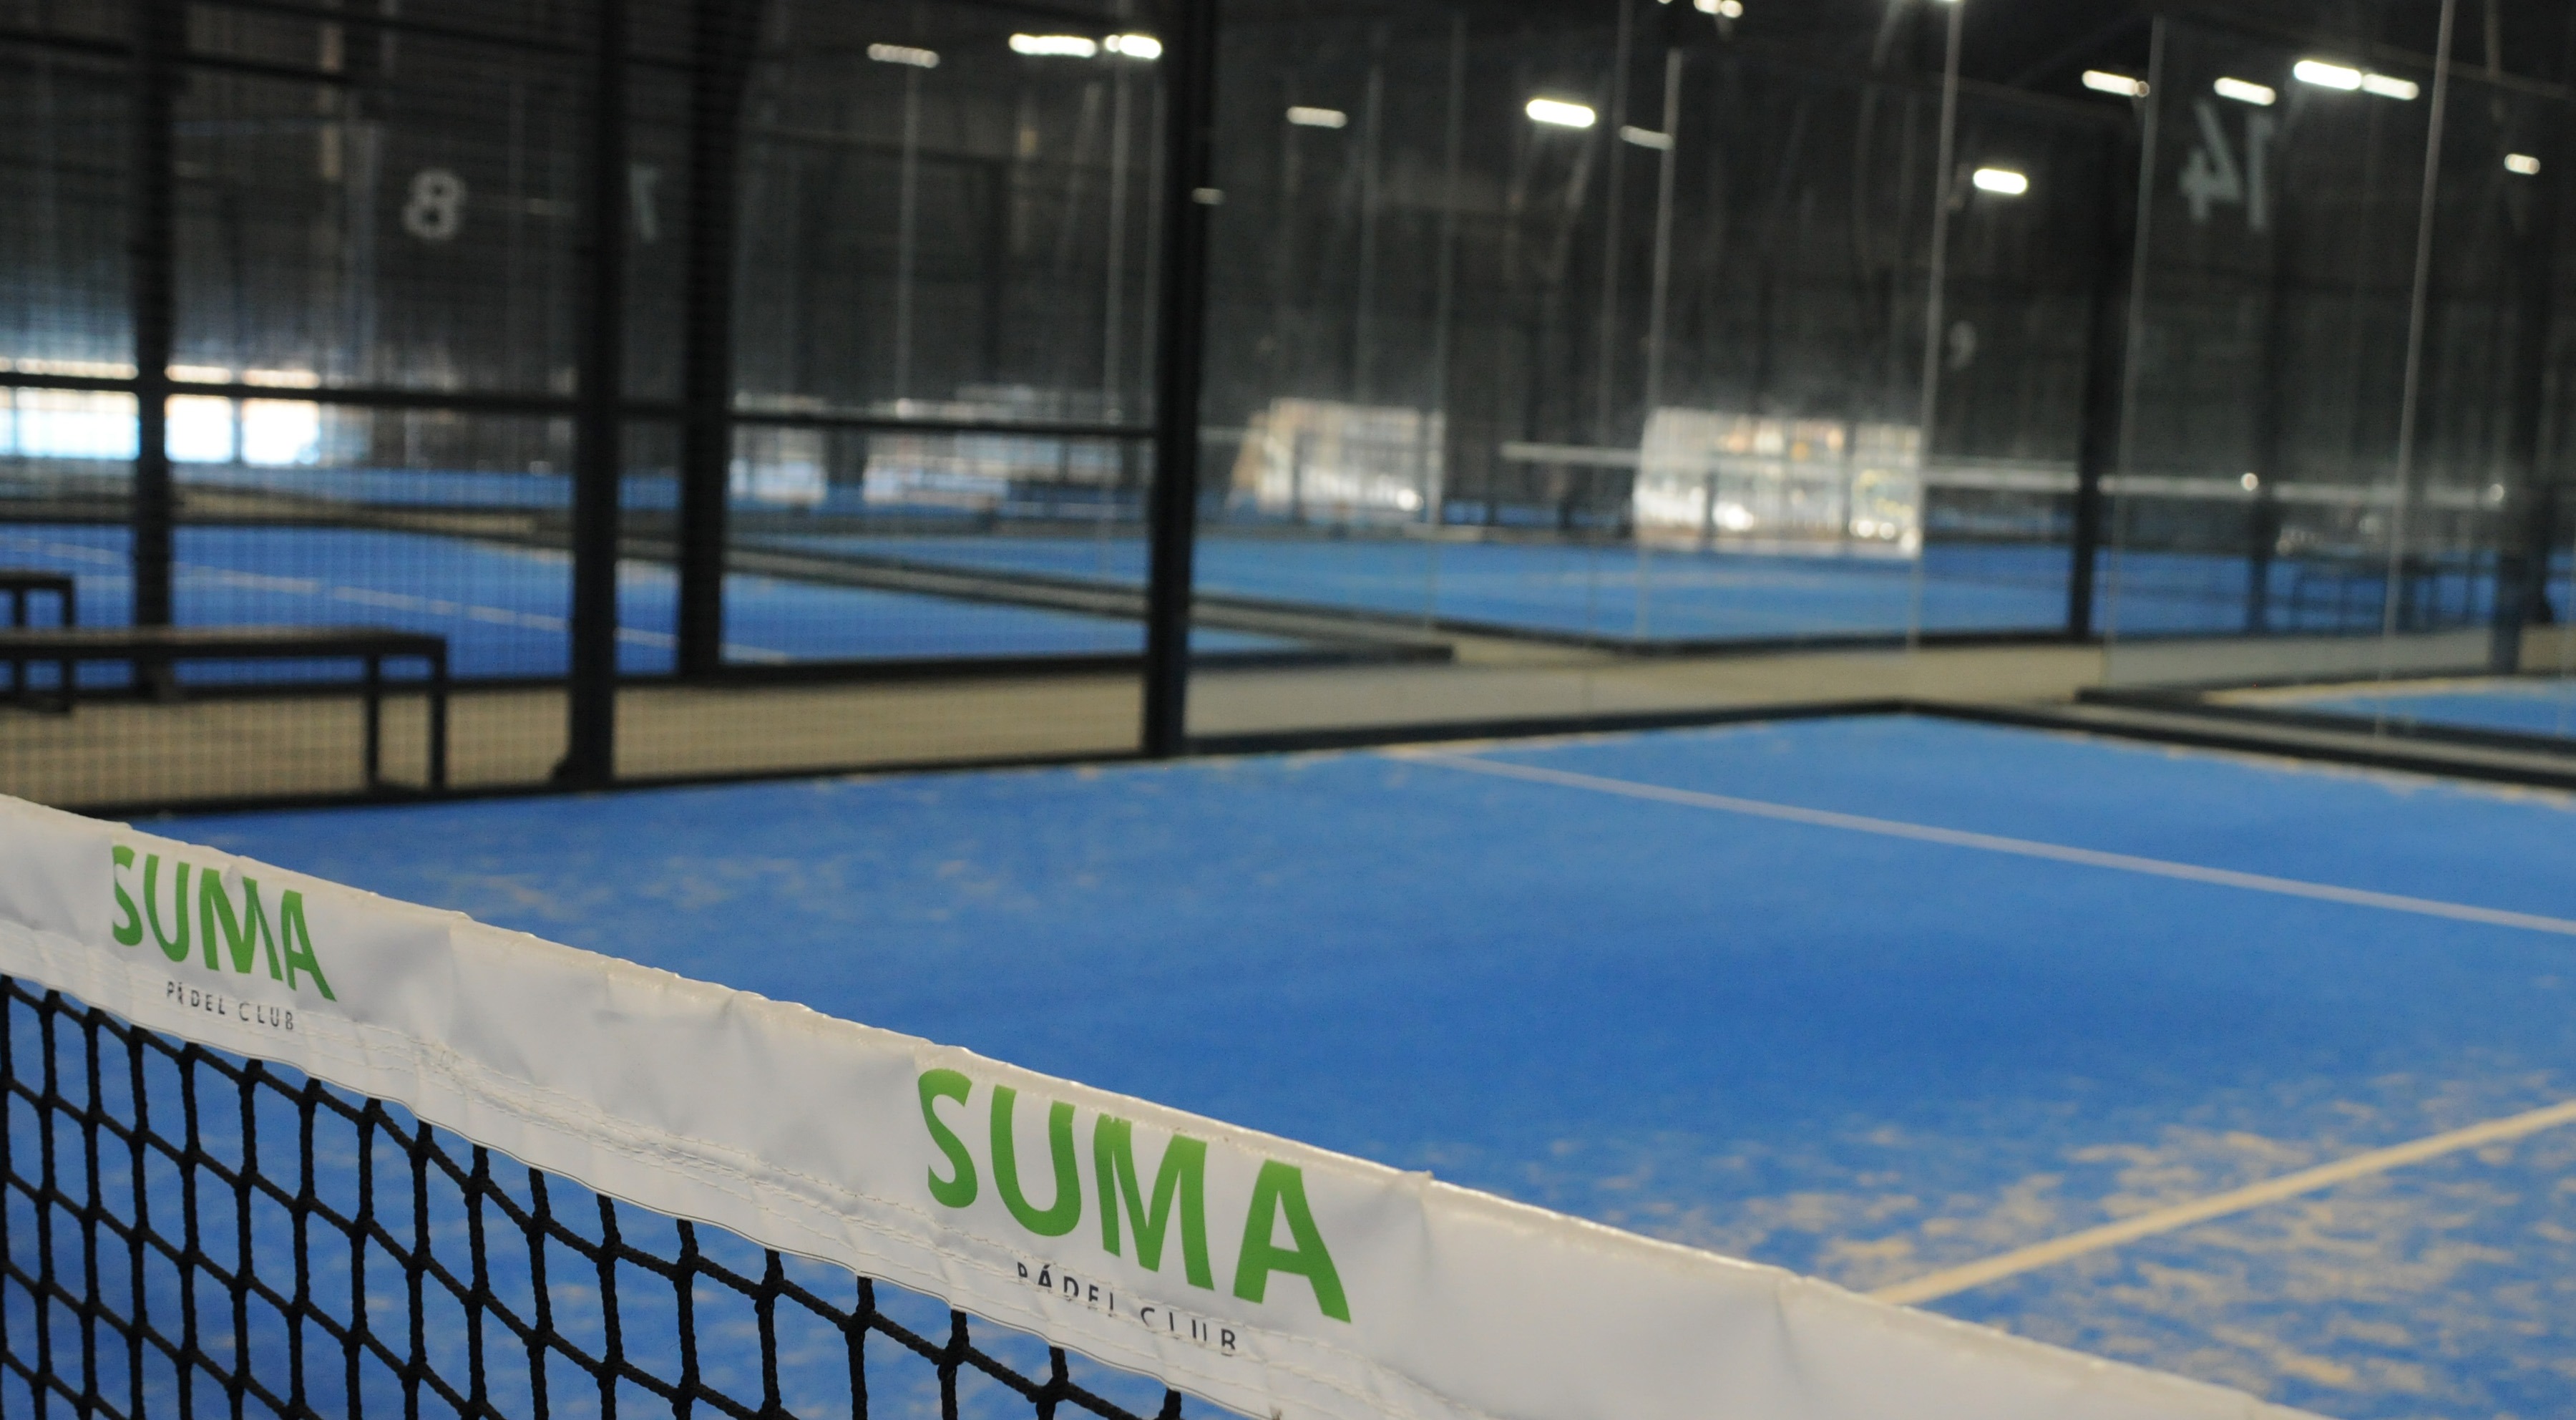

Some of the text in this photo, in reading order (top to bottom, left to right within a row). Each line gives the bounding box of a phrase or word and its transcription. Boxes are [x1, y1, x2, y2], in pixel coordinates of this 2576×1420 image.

[403, 167, 465, 240] 8
[112, 845, 336, 1002] SUMA
[239, 1003, 294, 1031] CLUB
[918, 1068, 1351, 1323] SUMA
